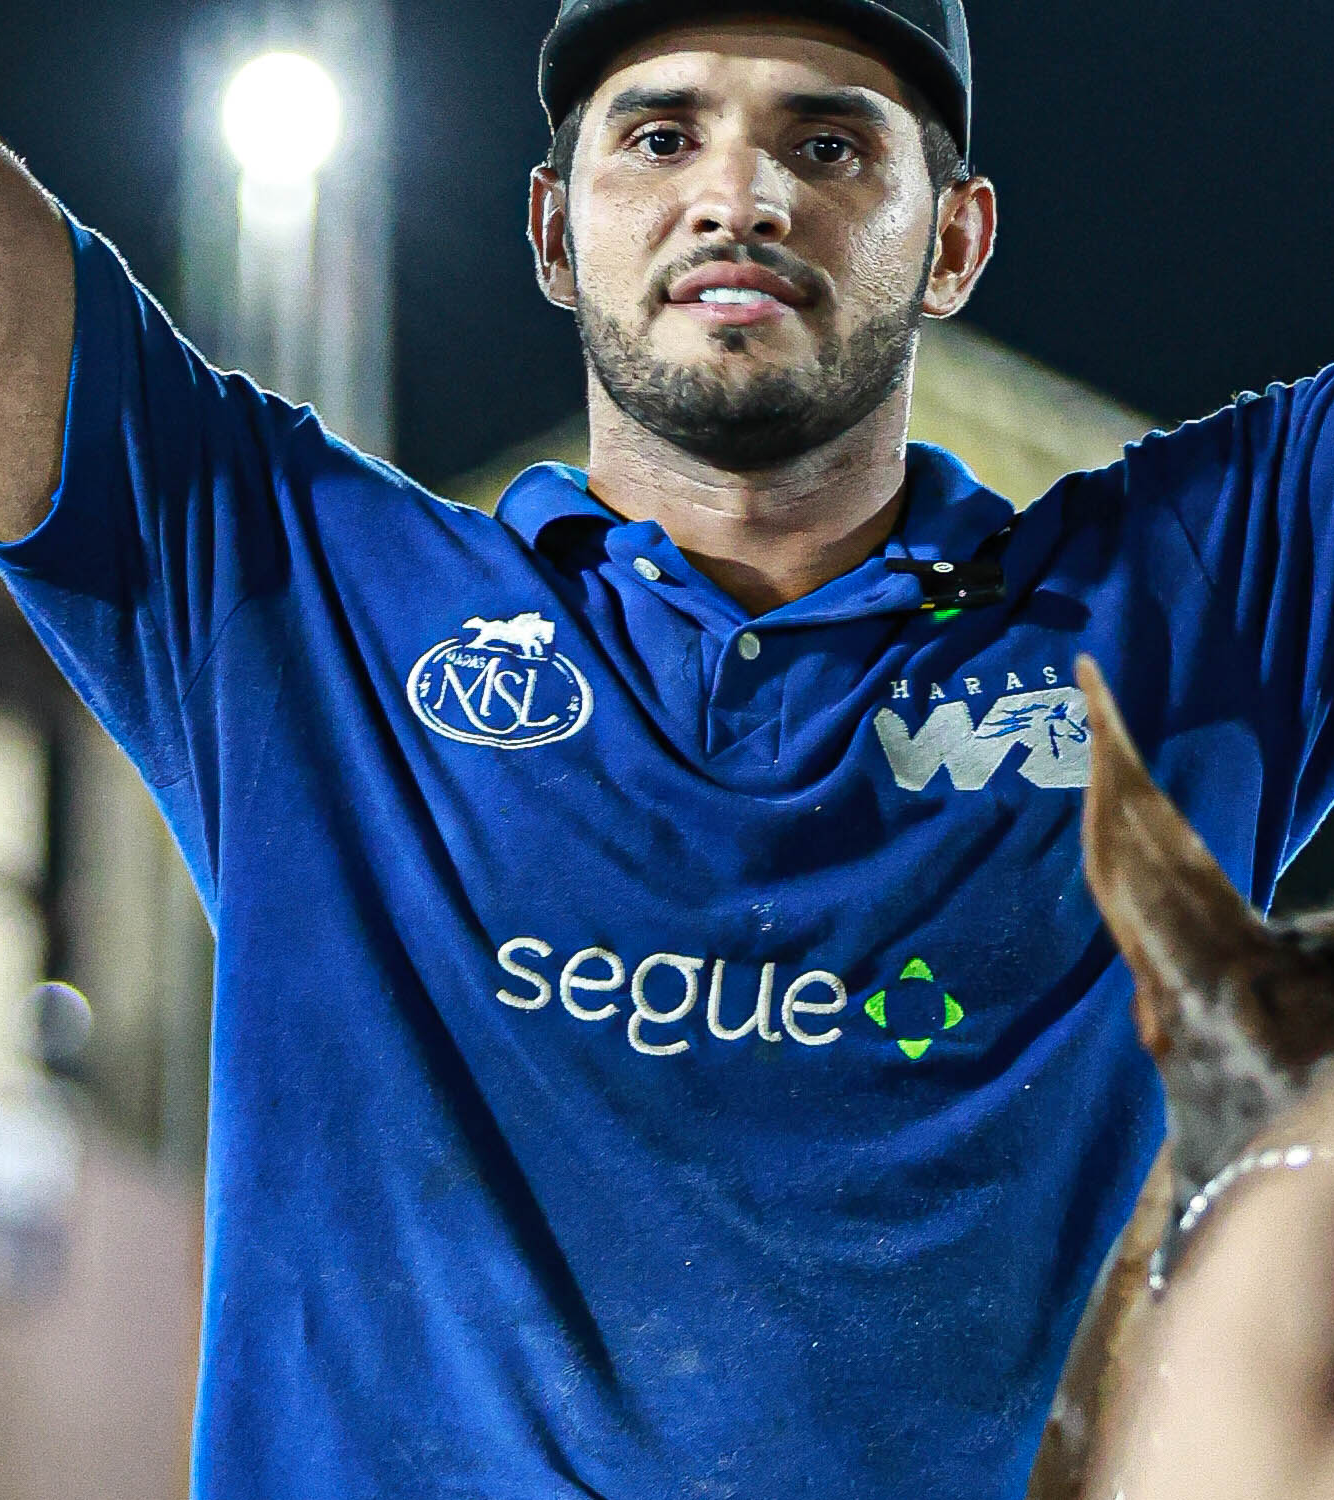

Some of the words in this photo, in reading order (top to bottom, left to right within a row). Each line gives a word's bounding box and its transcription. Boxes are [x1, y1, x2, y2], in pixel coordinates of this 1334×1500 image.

[433, 657, 560, 735] MSL
[890, 666, 1059, 699] HARAS
[496, 936, 848, 1056] segue
